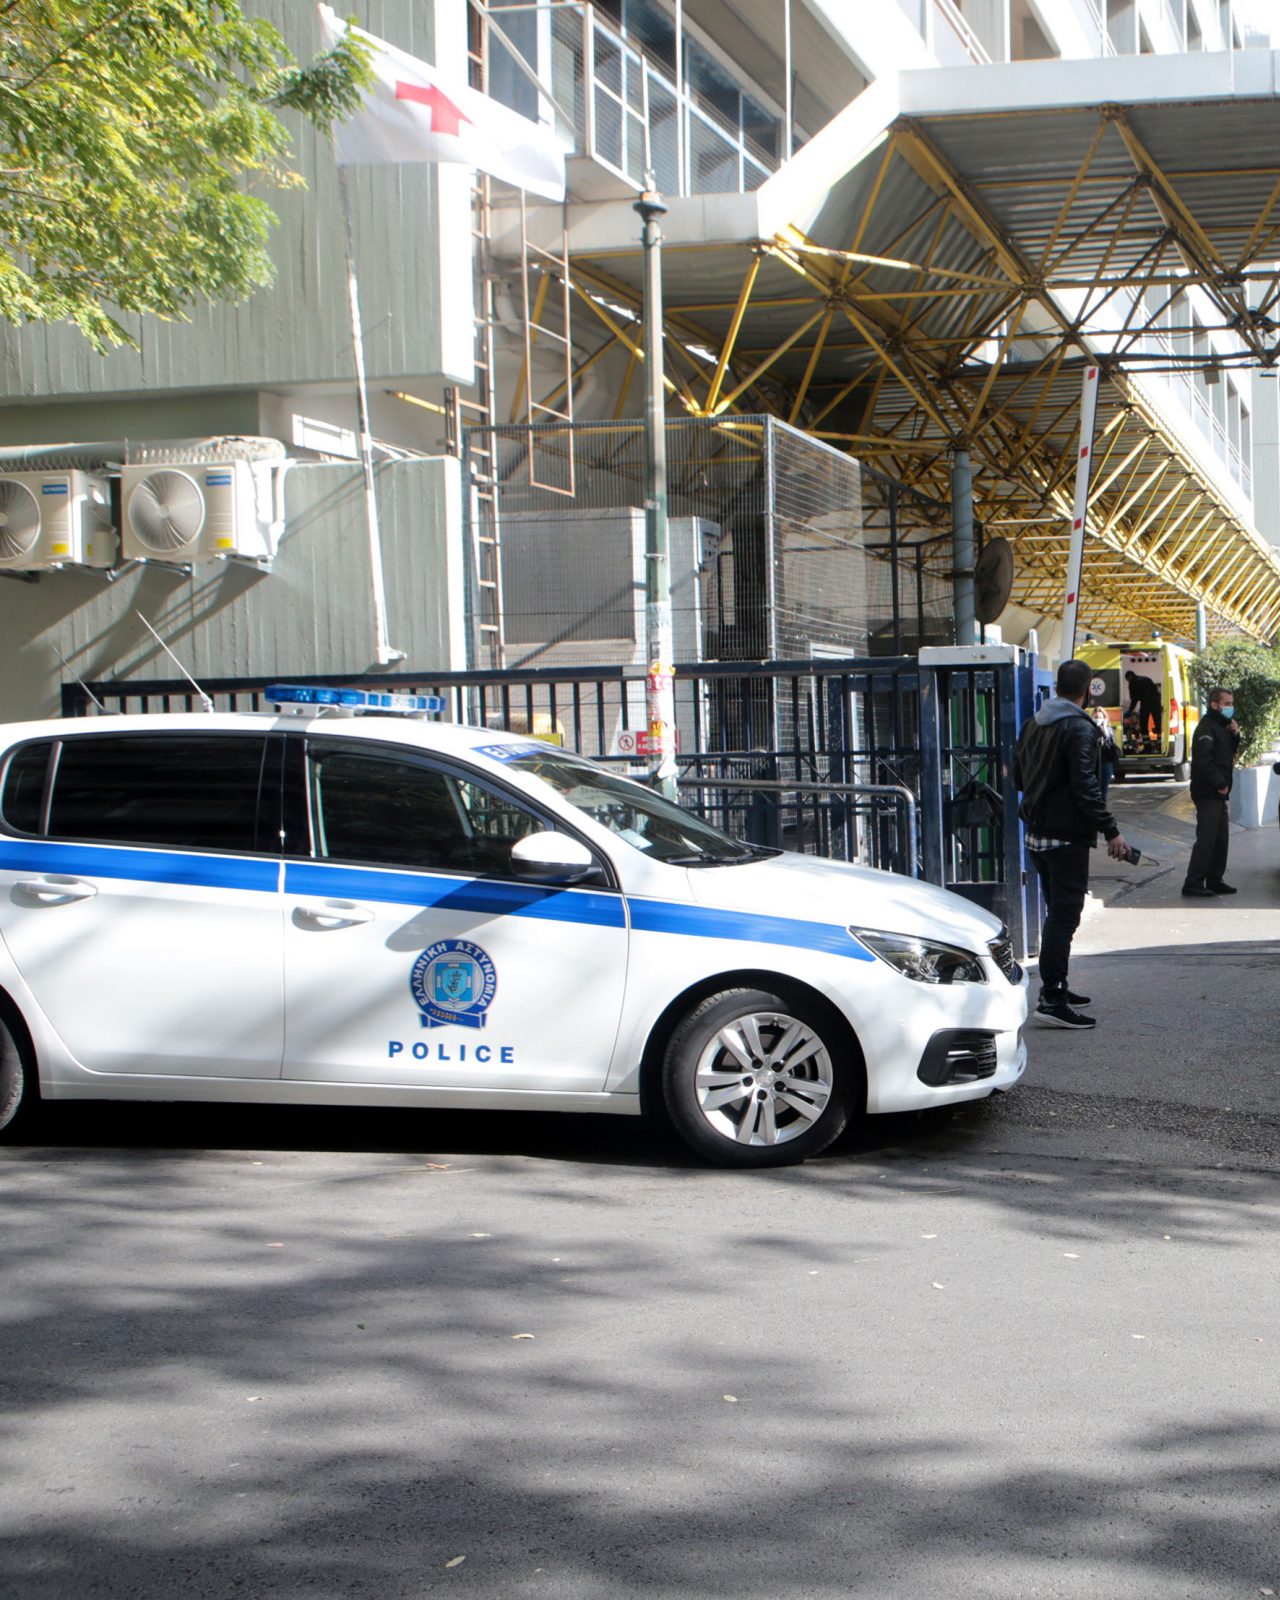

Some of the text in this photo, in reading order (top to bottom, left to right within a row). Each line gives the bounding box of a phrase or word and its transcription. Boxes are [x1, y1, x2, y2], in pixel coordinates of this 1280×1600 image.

[413, 941, 496, 1007] ΕΛΛΗΝΙΚΗ ΑΣΤΥΝΟΜΙΑ
[388, 1041, 514, 1064] POLICE
